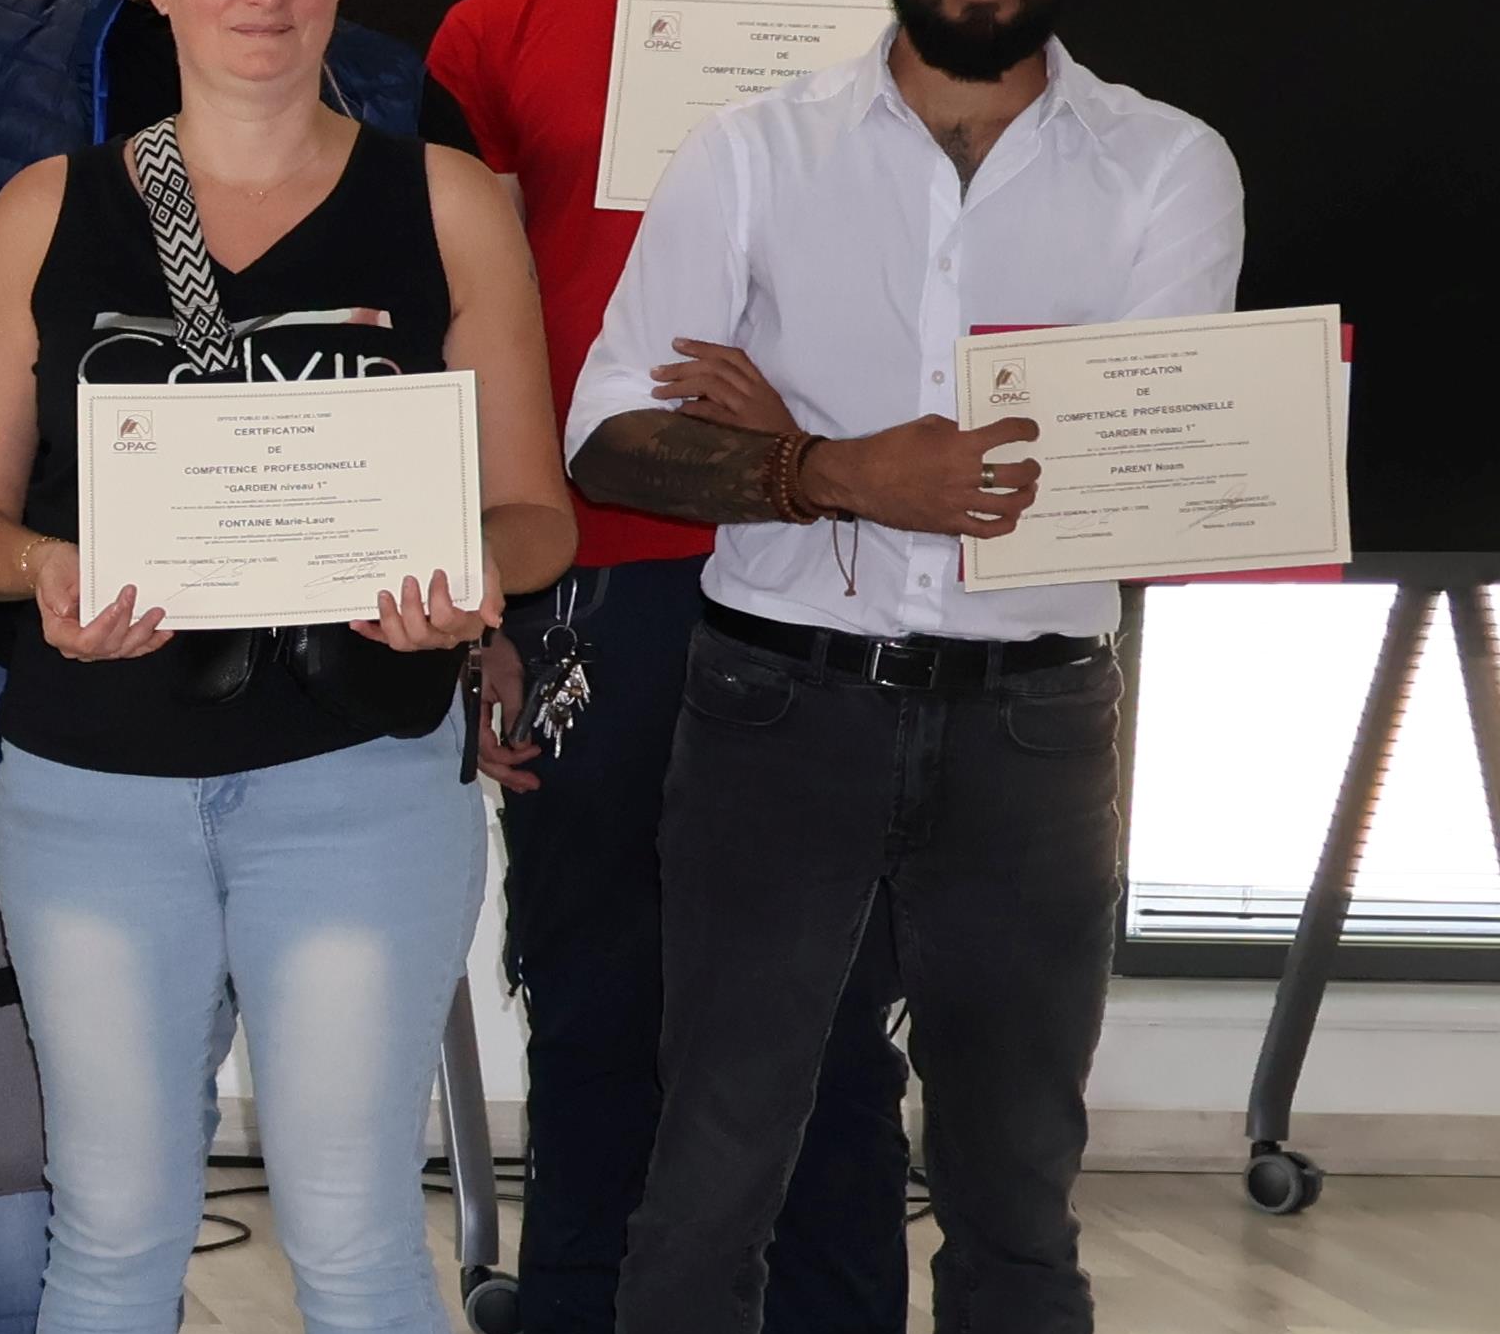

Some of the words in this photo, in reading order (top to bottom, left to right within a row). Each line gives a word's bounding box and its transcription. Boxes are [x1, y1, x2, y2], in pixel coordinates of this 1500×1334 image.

[750, 33, 820, 43] CERTIFICATION
[644, 40, 682, 50] OPAC
[776, 51, 789, 60] DE
[702, 66, 766, 76] COMPETENCE
[1103, 366, 1182, 379] CERTIFICATION
[989, 391, 1031, 404] OPAC
[1137, 388, 1150, 397] DE
[1056, 409, 1127, 423] COMPETENCE
[1133, 401, 1234, 417] PROFESSIONNELLE
[234, 425, 315, 437] CERTIFICATION
[1150, 426, 1183, 436] niveau
[113, 441, 157, 452] OPAC
[267, 445, 282, 454] DE
[184, 465, 258, 475] COMPETENCE
[263, 460, 367, 473] PROFESSIONNELLE
[1110, 464, 1153, 475] PARENT
[280, 482, 314, 492] niveau
[219, 518, 273, 528] FONTAINE
[275, 516, 335, 527] Marie-Laure
